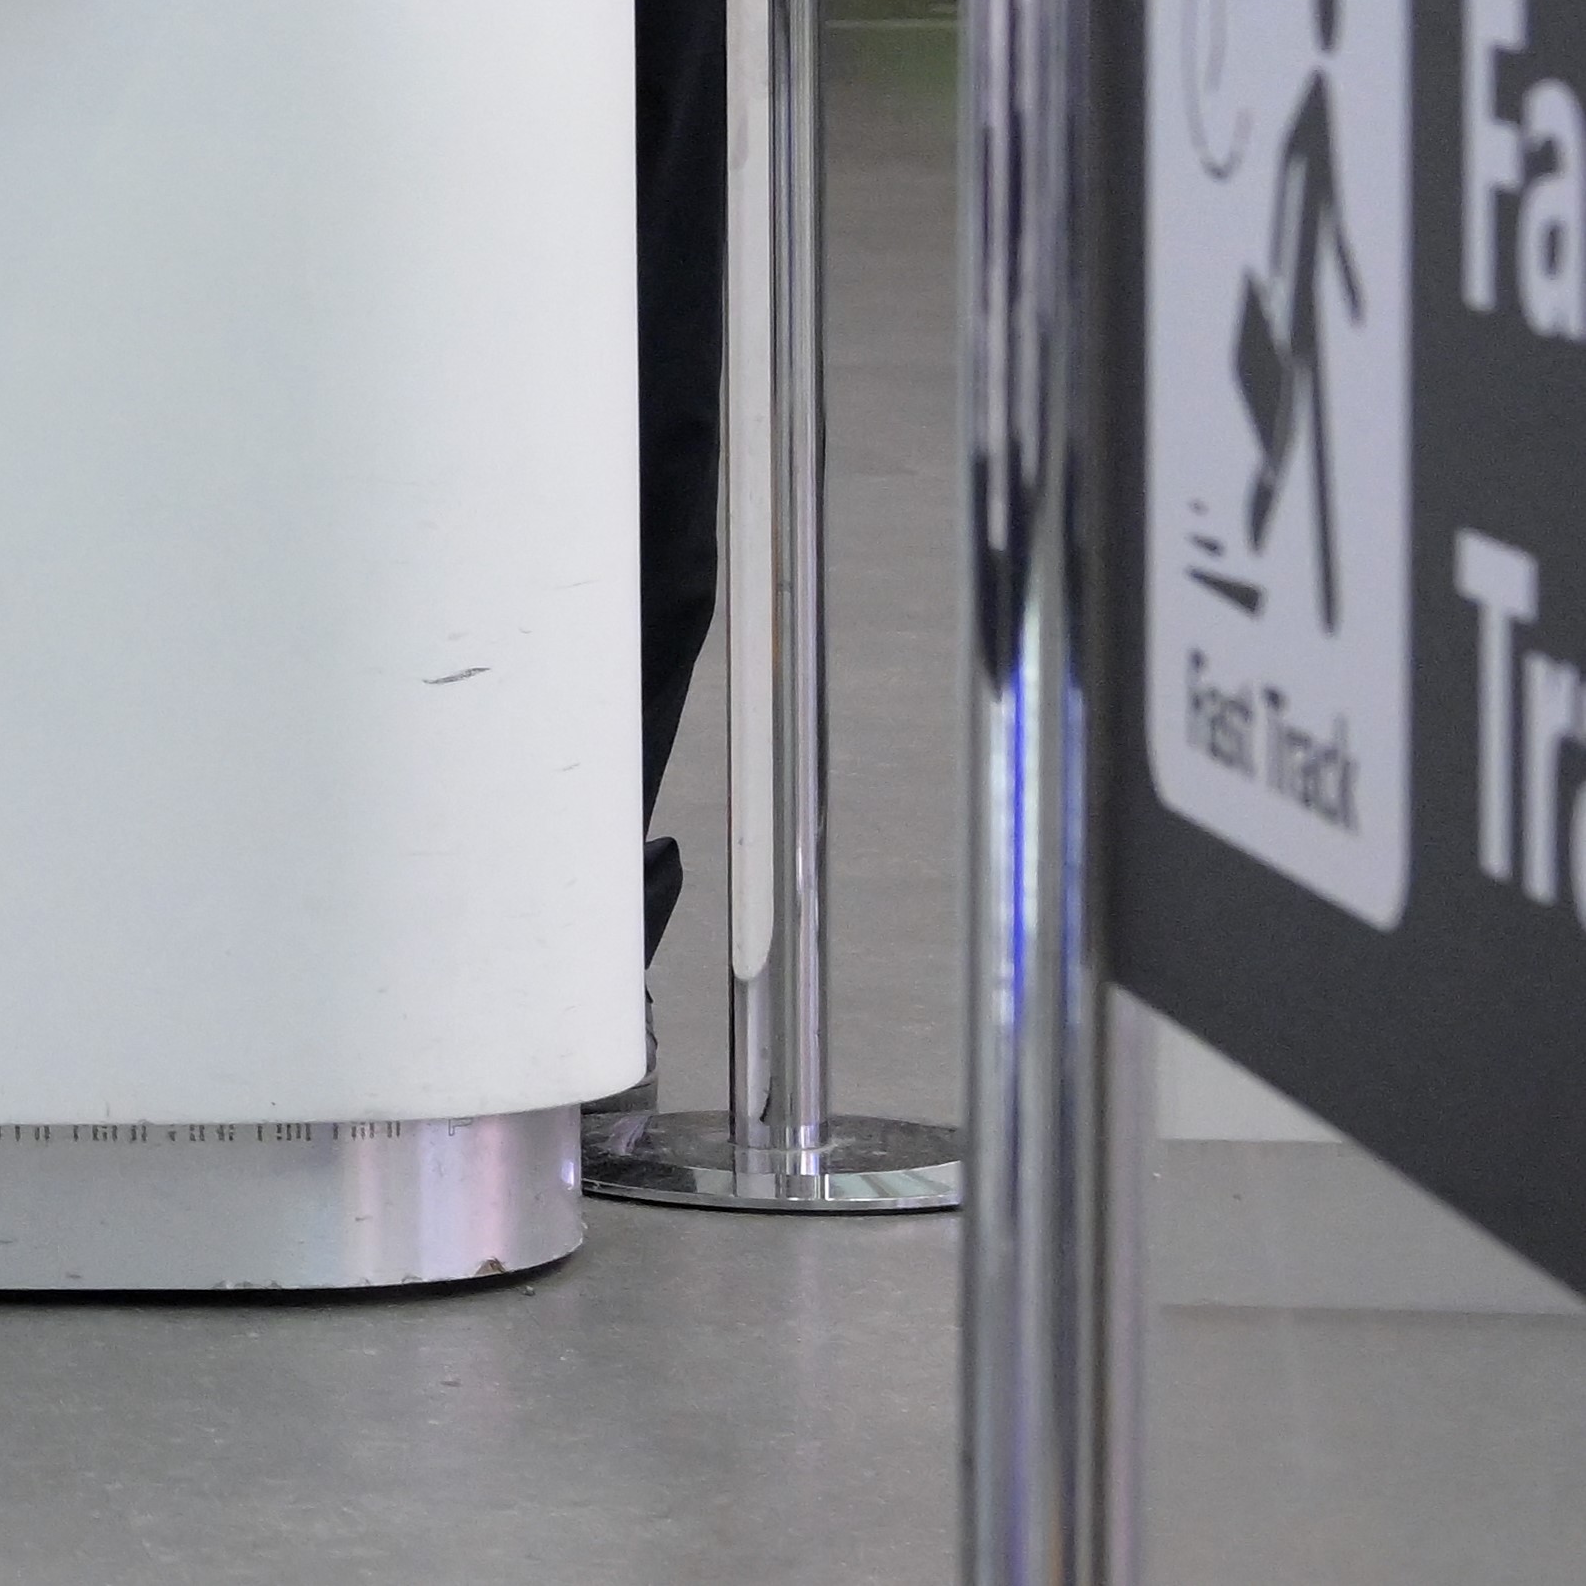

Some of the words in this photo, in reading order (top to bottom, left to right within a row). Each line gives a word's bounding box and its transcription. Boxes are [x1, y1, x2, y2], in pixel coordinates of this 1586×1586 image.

[1185, 644, 1258, 781] Fast
[1262, 682, 1360, 835] Track
[1454, 527, 1586, 929] Tr
